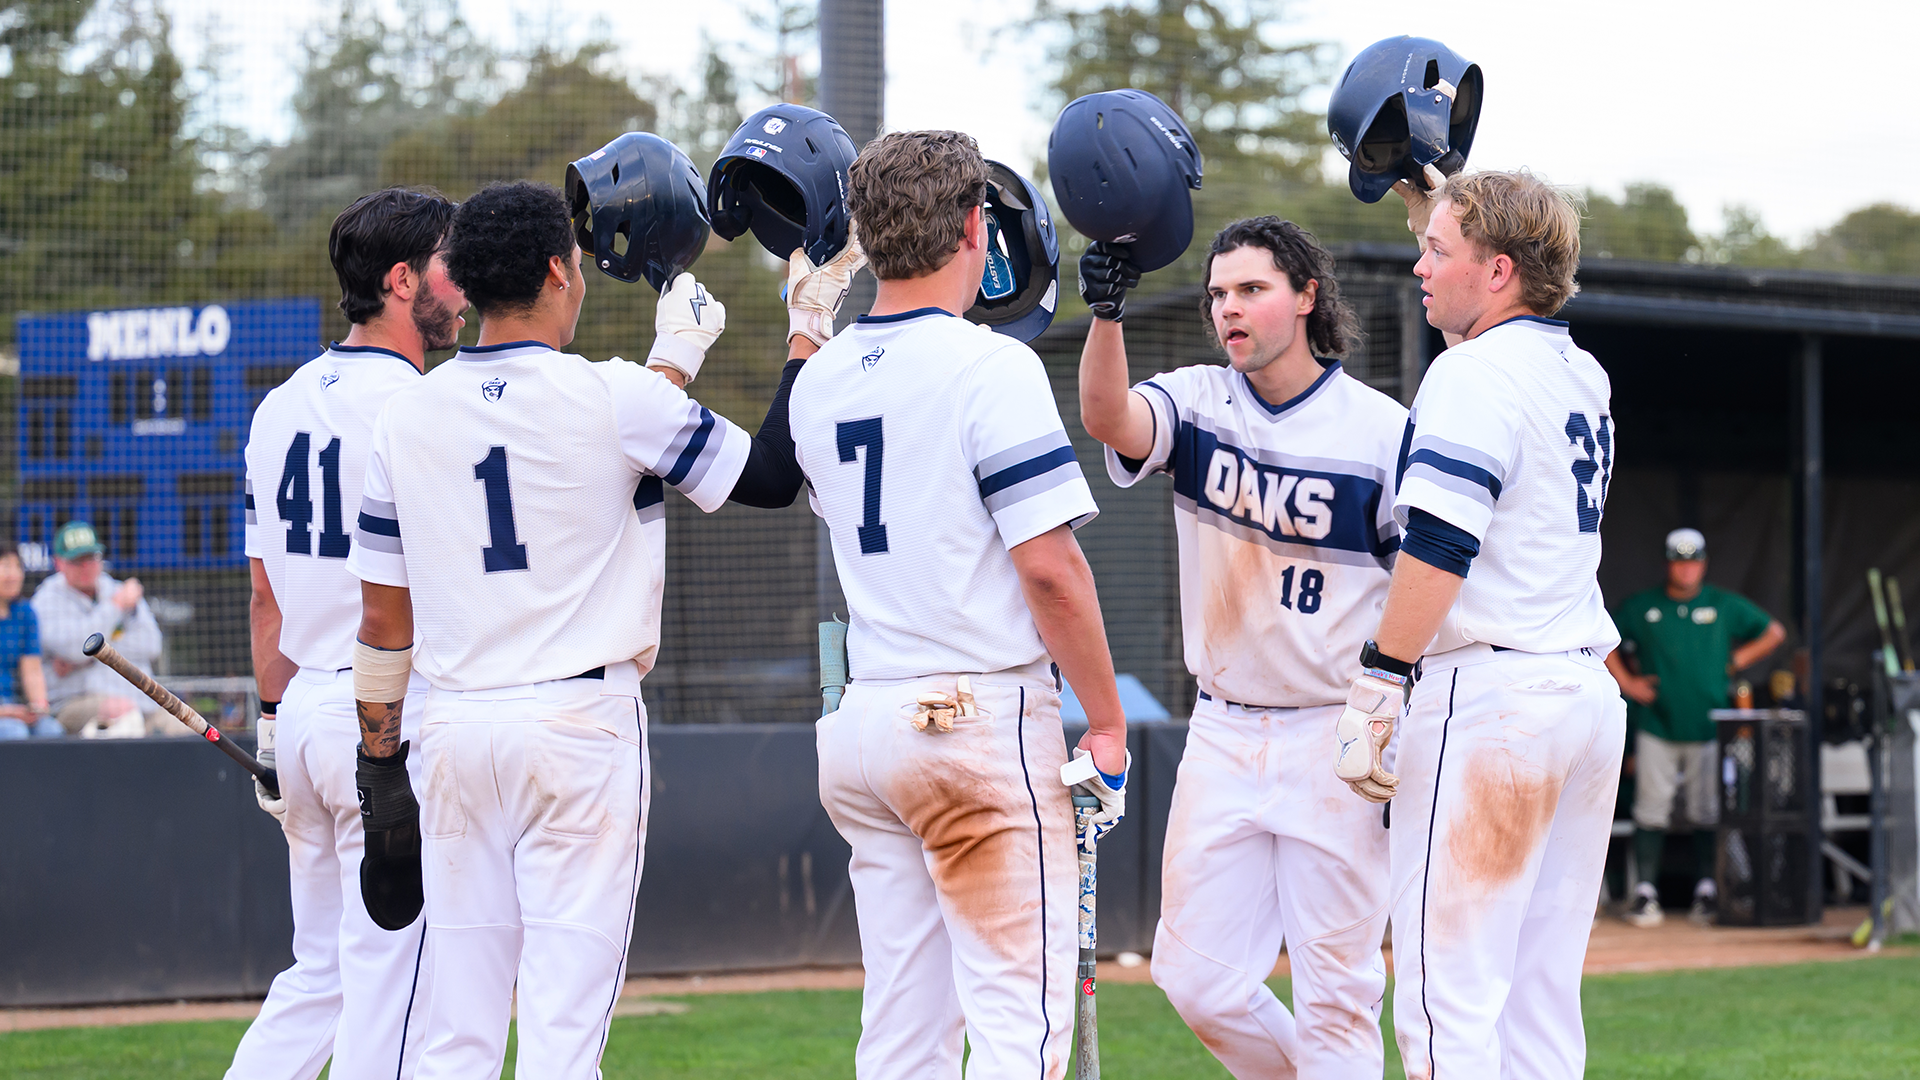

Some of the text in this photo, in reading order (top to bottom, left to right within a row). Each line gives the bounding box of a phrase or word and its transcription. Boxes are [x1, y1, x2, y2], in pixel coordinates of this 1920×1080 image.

[86, 304, 231, 362] MENLO
[276, 430, 351, 559] 41
[472, 444, 531, 575] 1
[835, 414, 890, 556] 7
[1203, 447, 1336, 540] OAKS
[1279, 564, 1325, 615] 18
